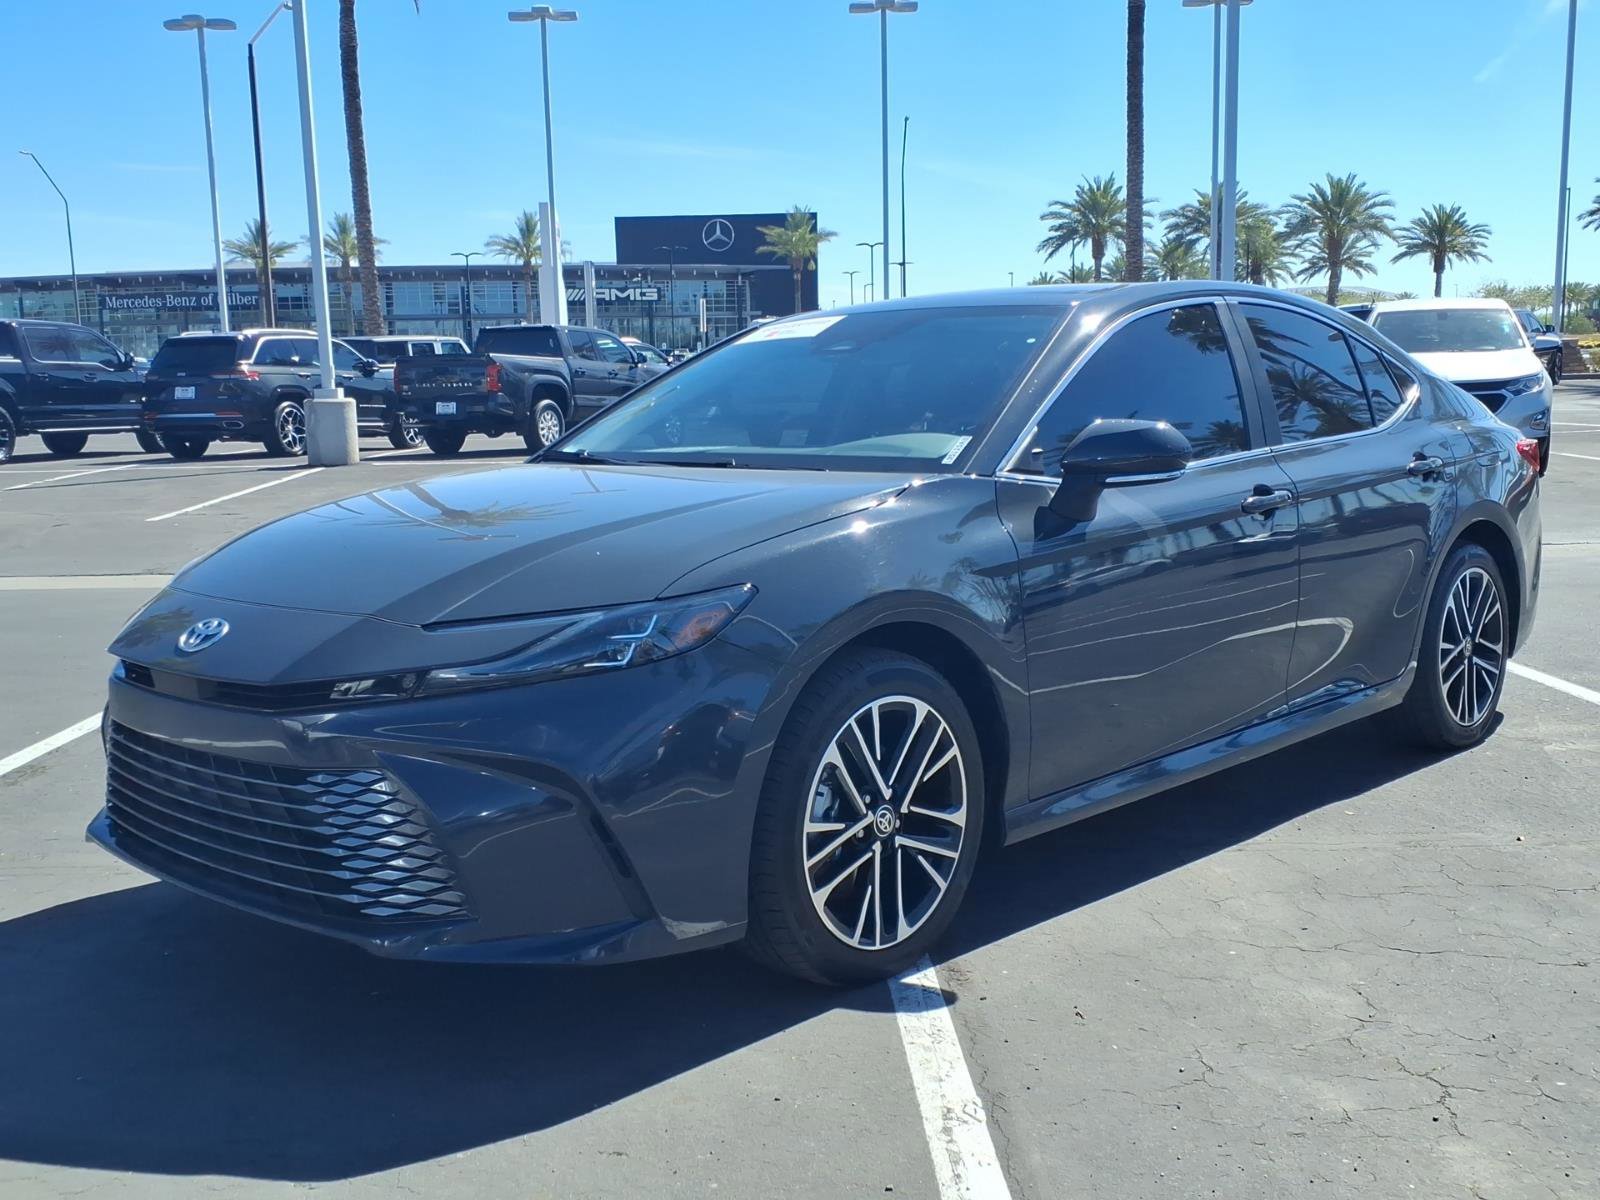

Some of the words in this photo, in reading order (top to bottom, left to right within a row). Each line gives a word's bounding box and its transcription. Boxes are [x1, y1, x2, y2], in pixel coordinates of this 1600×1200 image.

[105, 294, 197, 309] Mercedes-Benz
[201, 293, 214, 306] of
[594, 289, 658, 301] AMG
